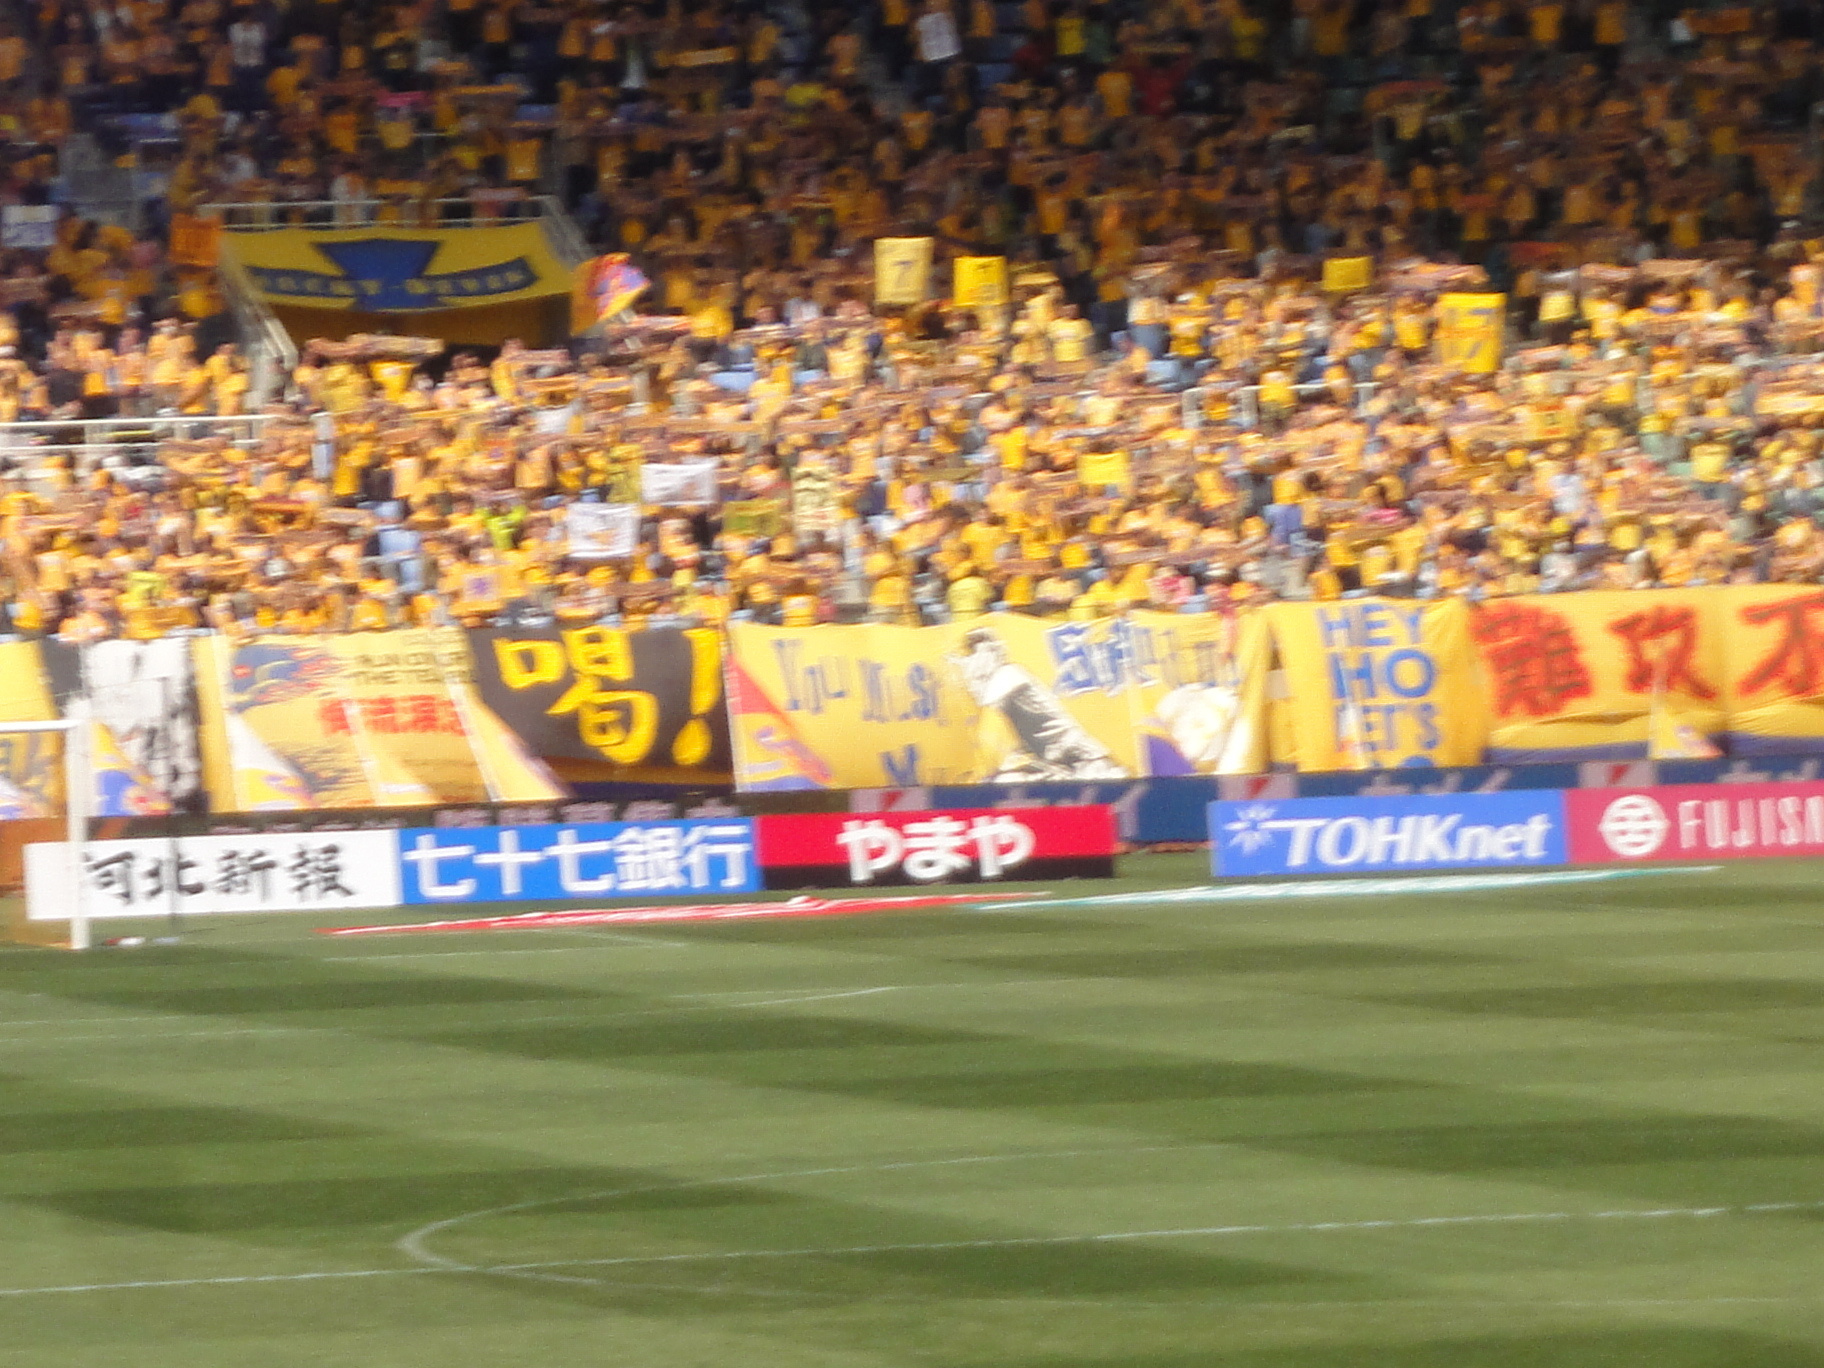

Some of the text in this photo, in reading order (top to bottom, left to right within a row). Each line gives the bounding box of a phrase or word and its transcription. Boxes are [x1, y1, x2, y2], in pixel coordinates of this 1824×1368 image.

[1314, 603, 1426, 647] HEY
[1329, 648, 1437, 700] HO
[403, 824, 751, 896] 七十七銀行
[836, 815, 1036, 884] やまや
[1264, 813, 1553, 868] TOHKnet
